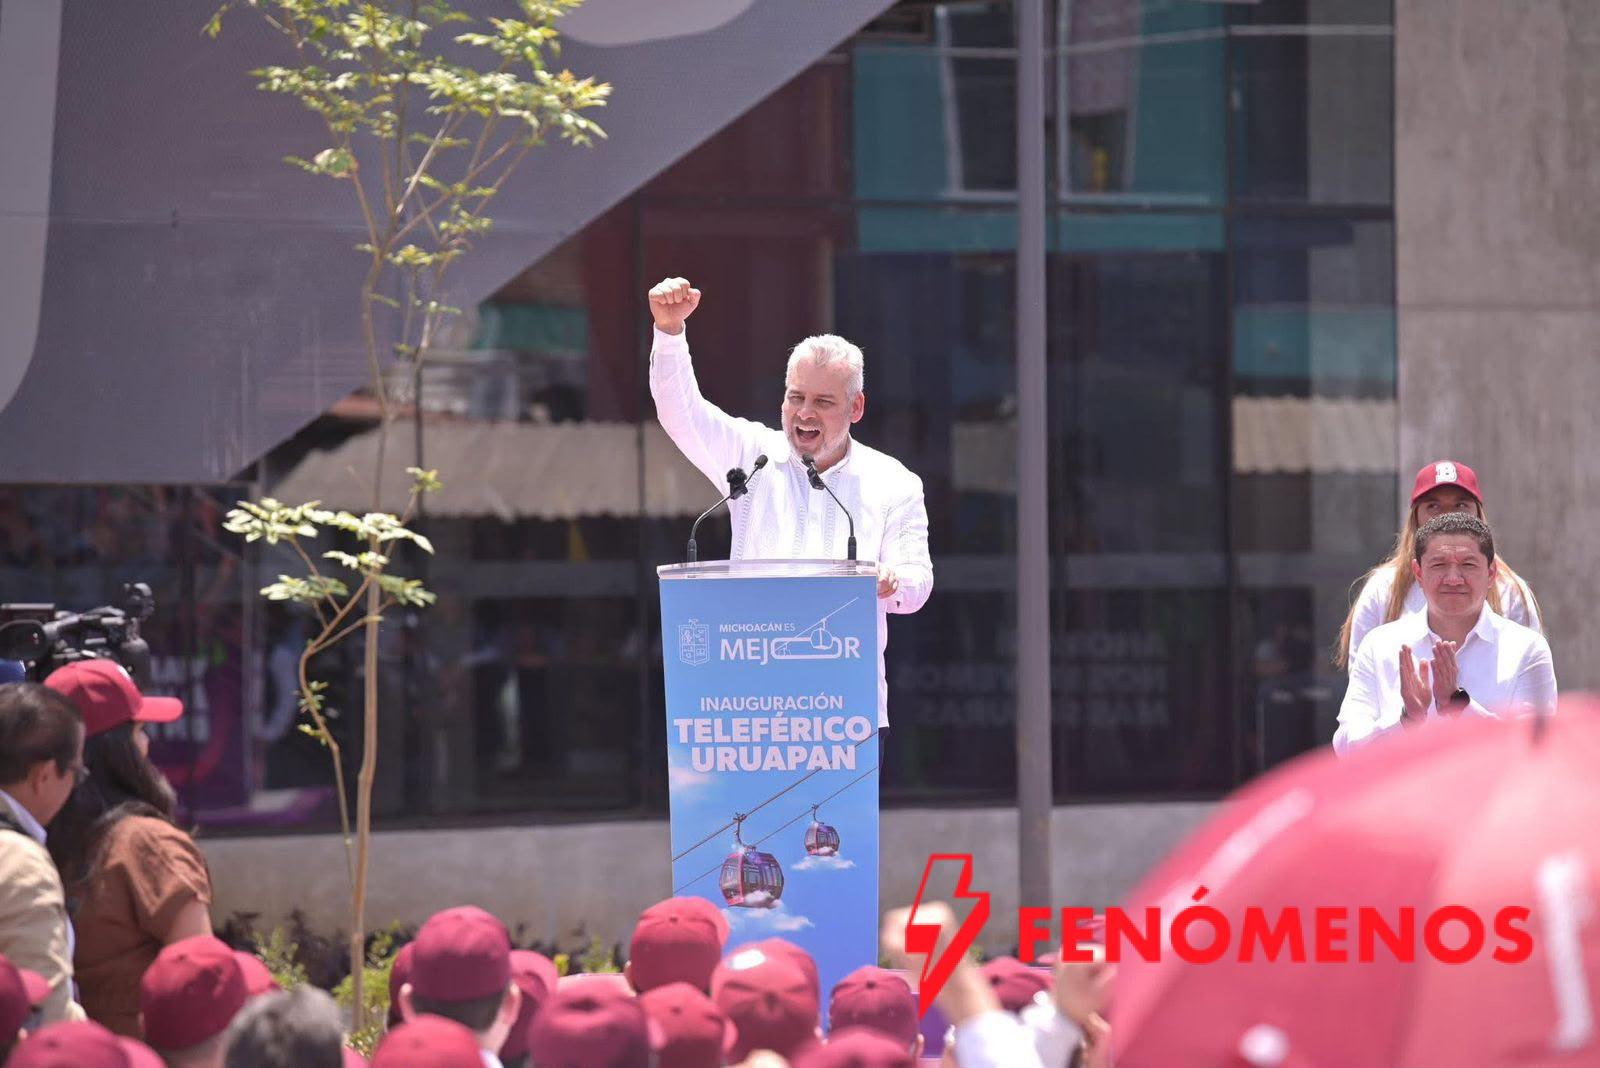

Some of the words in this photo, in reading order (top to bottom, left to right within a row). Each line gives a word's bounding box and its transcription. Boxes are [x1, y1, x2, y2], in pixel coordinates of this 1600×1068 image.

[1435, 461, 1457, 484] B
[719, 621, 782, 633] MICHOACÁN
[784, 623, 796, 632] ES
[720, 636, 861, 665] MEJOR
[700, 692, 843, 711] INAUGURACIÓN
[673, 712, 872, 744] TELEFÉRICO
[691, 744, 856, 772] URUAPAN
